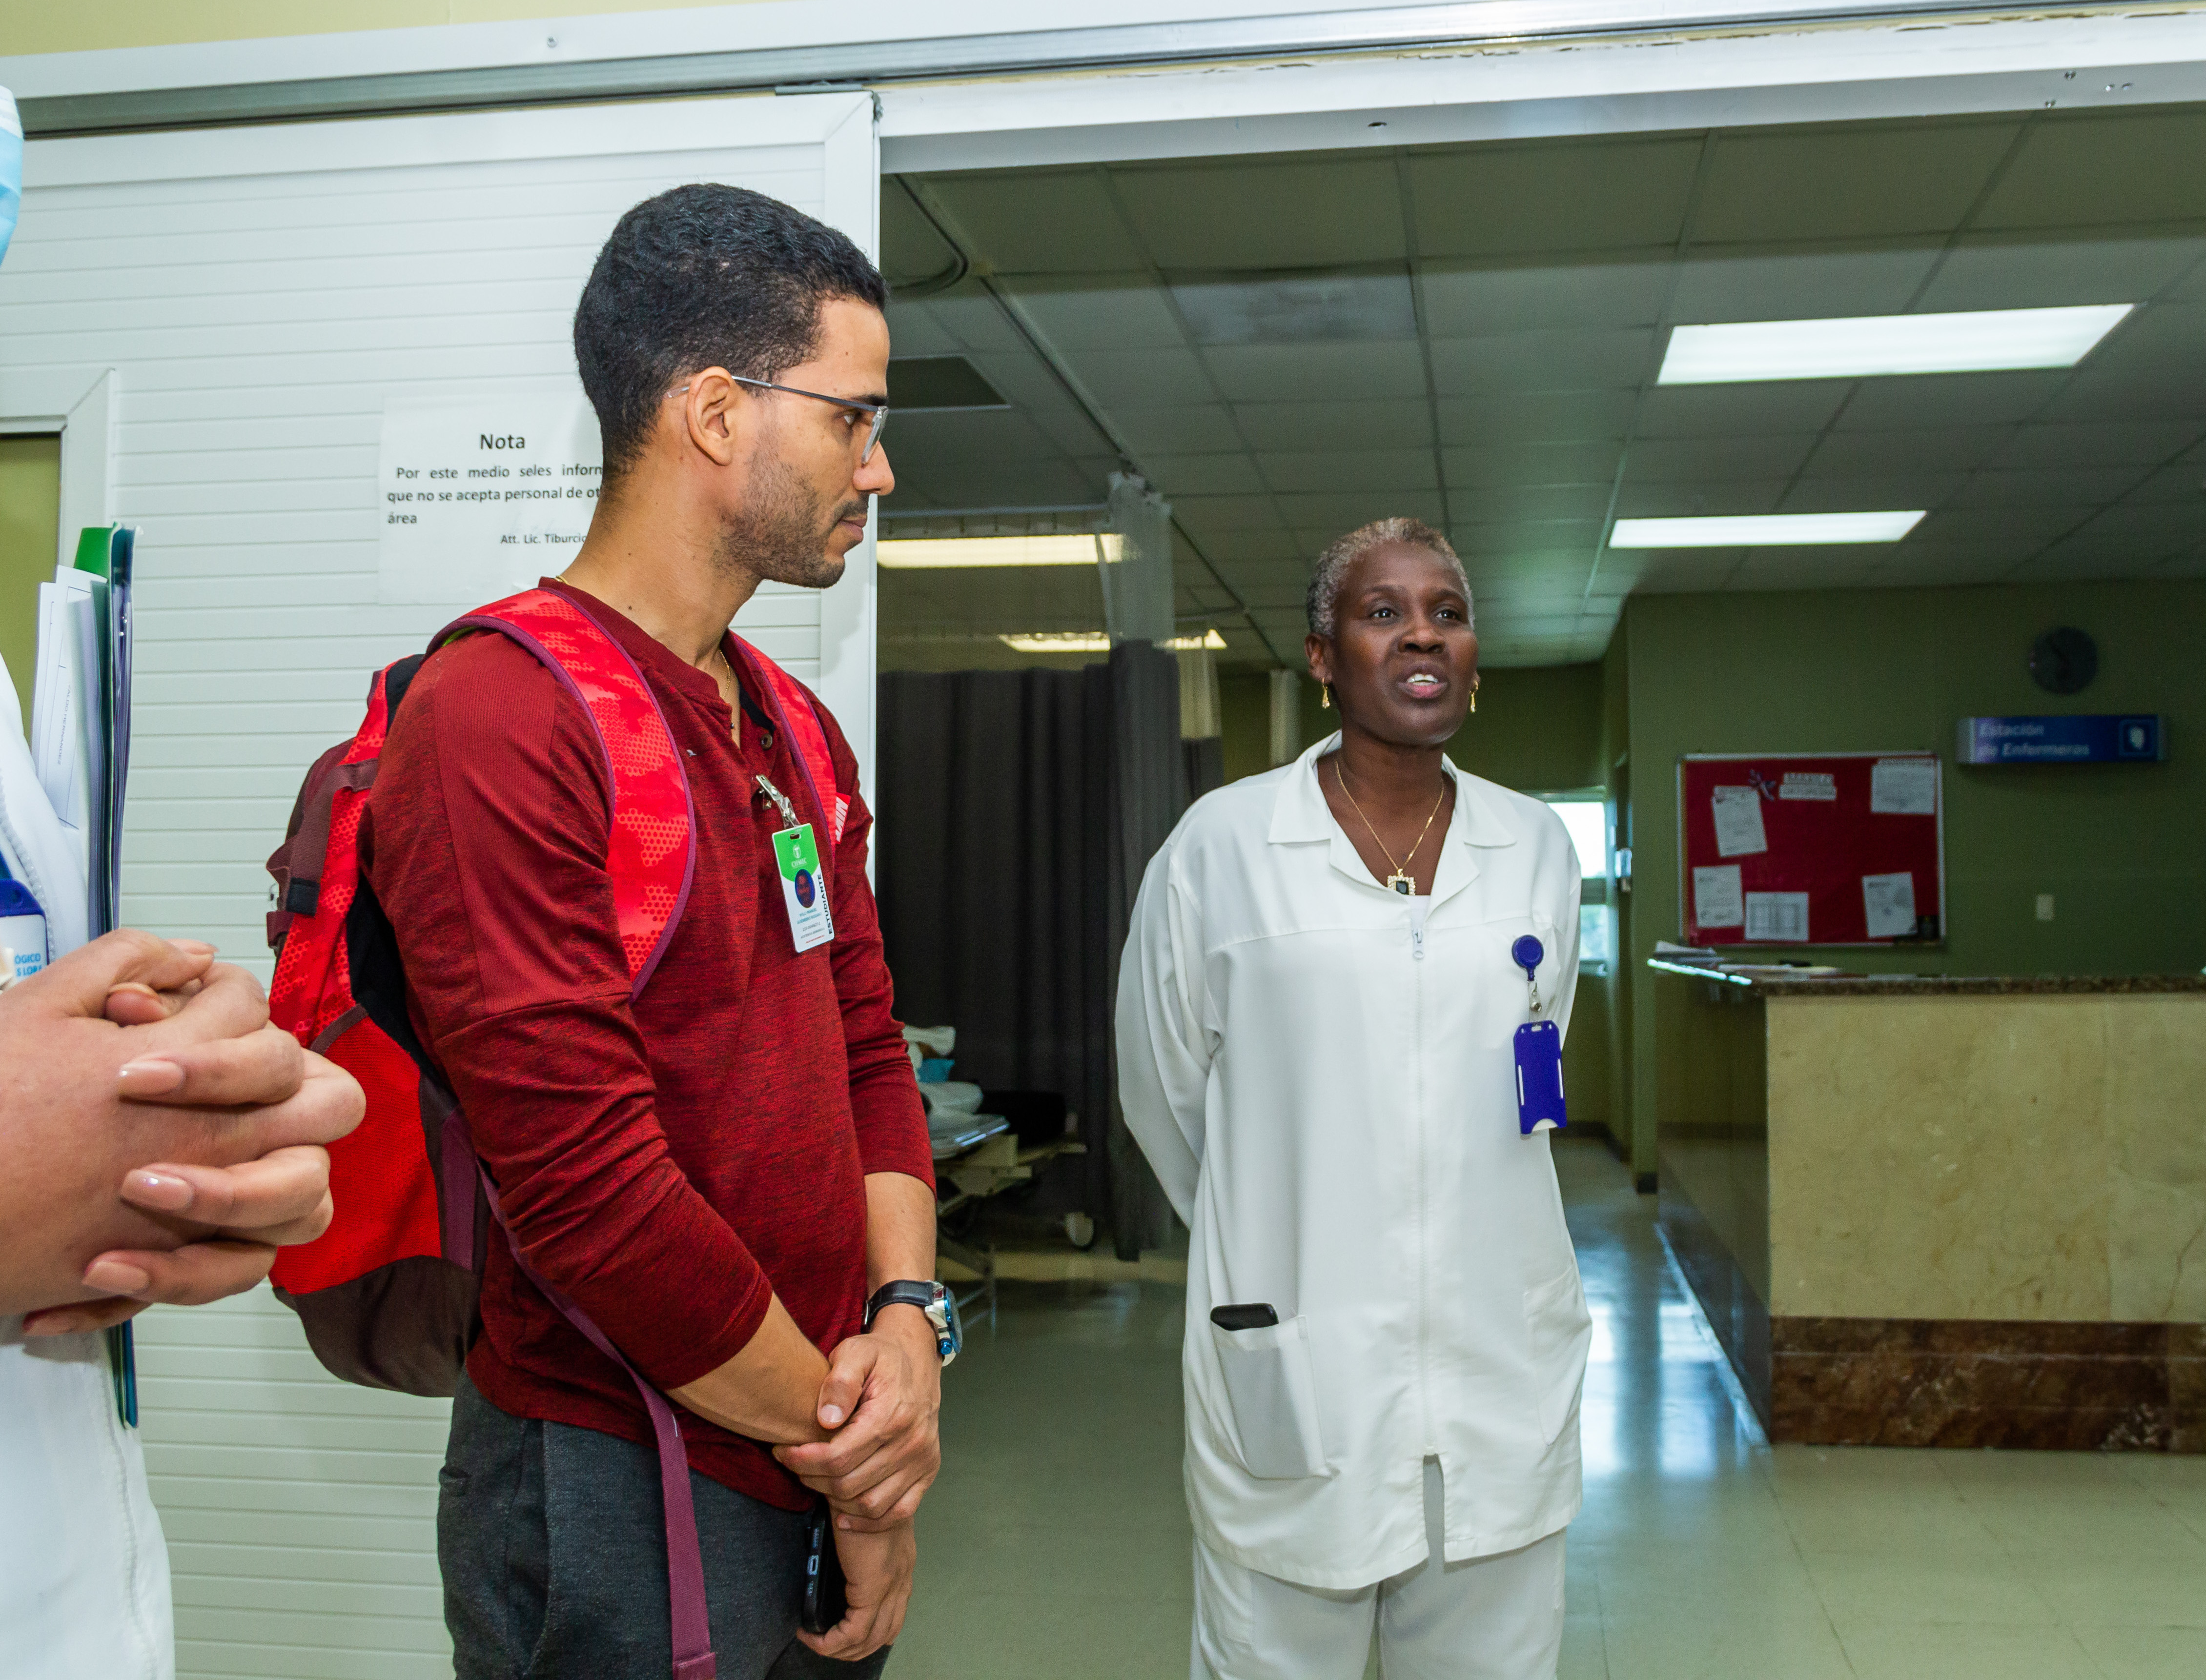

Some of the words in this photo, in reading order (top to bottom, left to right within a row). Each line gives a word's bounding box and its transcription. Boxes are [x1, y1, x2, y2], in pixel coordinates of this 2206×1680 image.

[479, 433, 526, 450] Nota
[396, 466, 420, 480] Por
[429, 467, 459, 480] este
[467, 465, 511, 479] medio
[519, 464, 552, 478] seles
[386, 492, 413, 505] que
[416, 492, 435, 502] no
[438, 491, 453, 502] se
[456, 489, 501, 504] acepta
[504, 486, 563, 503] personal
[566, 486, 583, 499] de
[387, 511, 418, 525] área
[500, 534, 520, 545] Att.
[523, 533, 541, 544] Lic.
[817, 874, 832, 934] ESTUDIANTE
